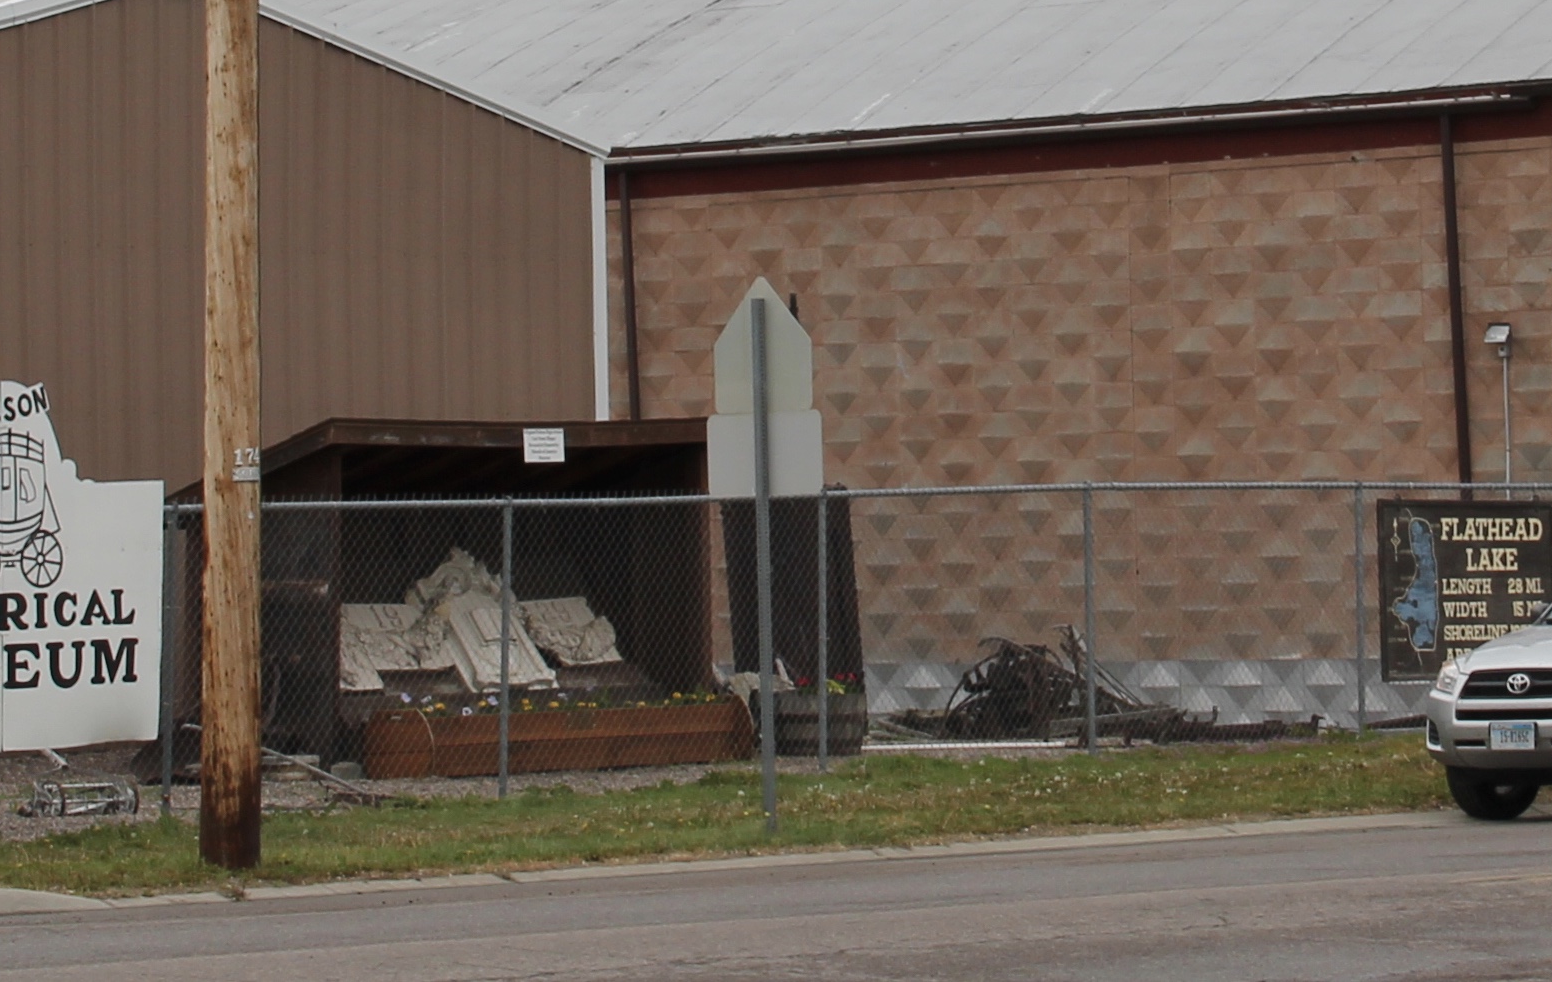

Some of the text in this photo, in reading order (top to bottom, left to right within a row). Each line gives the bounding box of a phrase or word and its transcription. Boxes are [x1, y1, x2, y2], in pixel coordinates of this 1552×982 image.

[1440, 517, 1543, 541] FLATHEAD
[1465, 547, 1518, 571] LAKE
[1442, 577, 1545, 595] LENGTH 28 MI.
[1443, 601, 1488, 618] WIDTH
[1512, 601, 1524, 617] 15
[1443, 624, 1508, 641] SHORELINE
